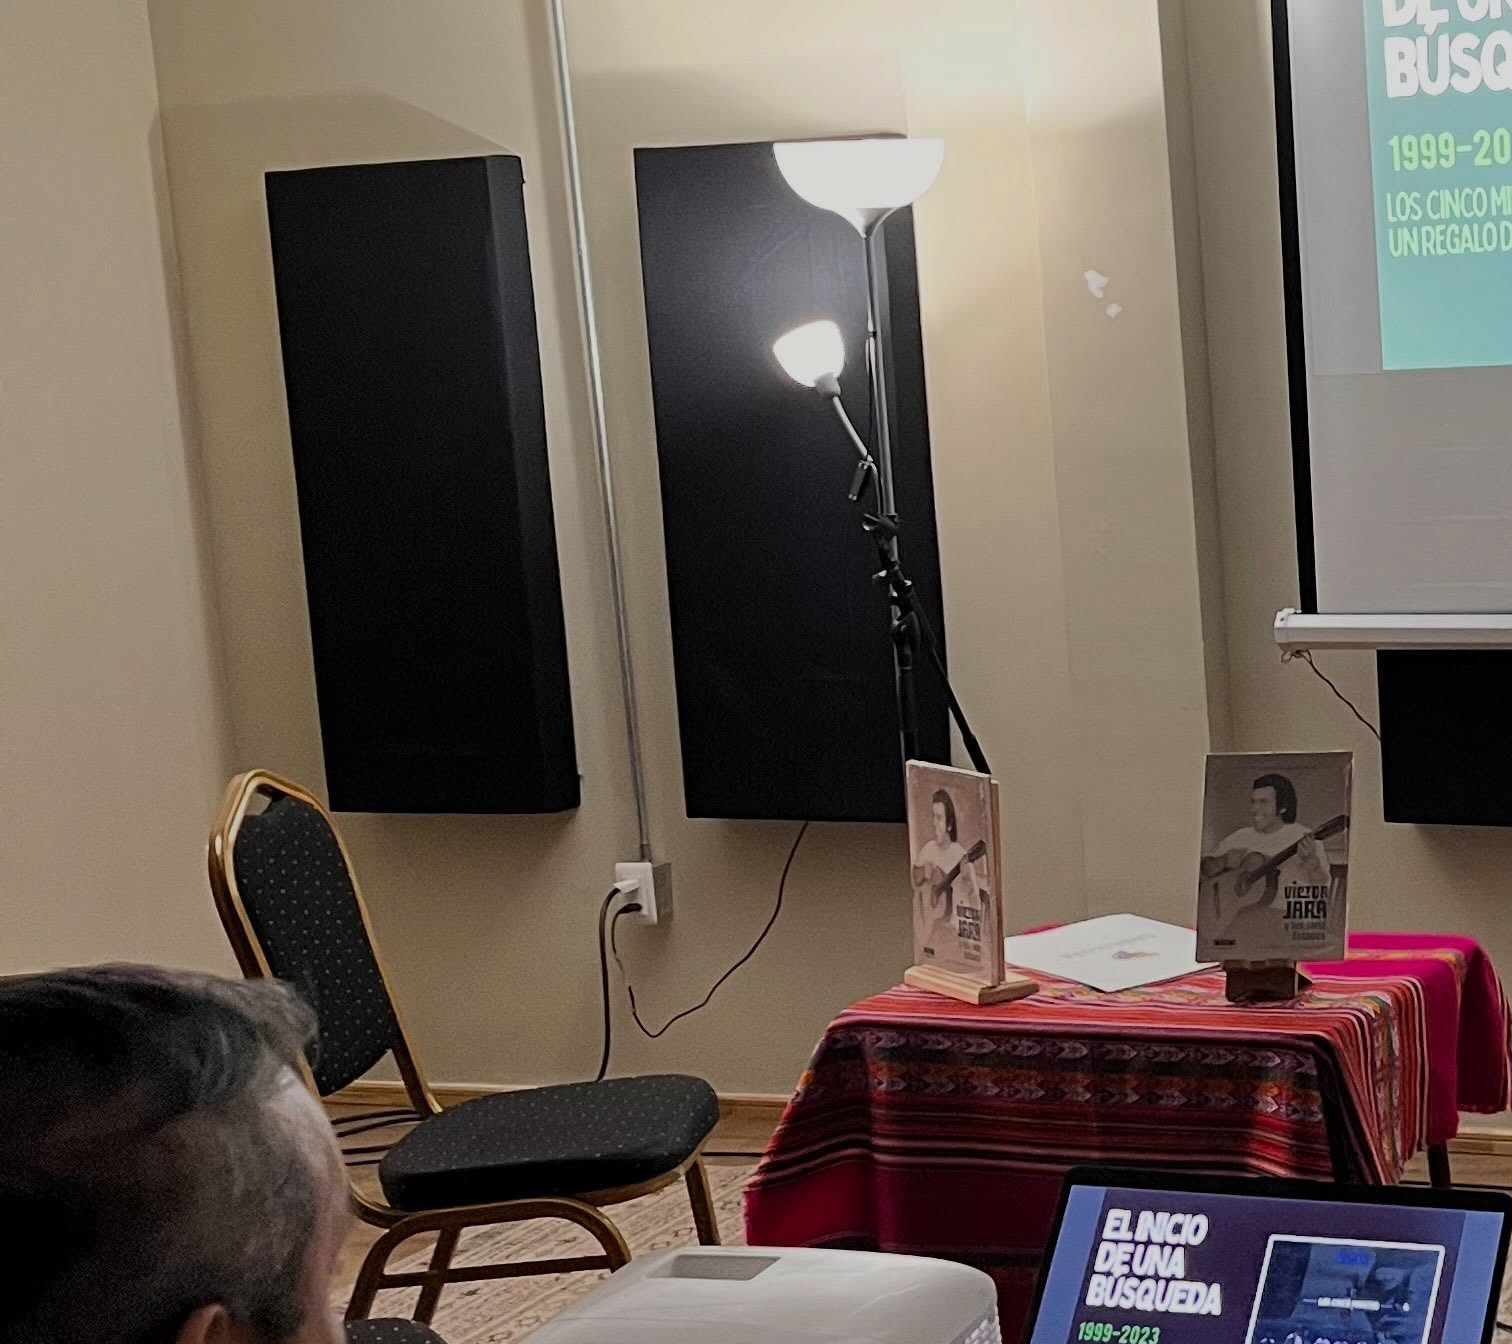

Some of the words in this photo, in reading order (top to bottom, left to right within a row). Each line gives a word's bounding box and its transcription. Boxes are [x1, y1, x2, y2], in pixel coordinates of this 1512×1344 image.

[1386, 192, 1422, 223] LOS
[1426, 187, 1488, 220] CINCO
[1388, 226, 1420, 257] UN
[1421, 221, 1497, 256] REGALO
[1282, 900, 1327, 919] JARA
[1102, 1208, 1133, 1241] EL
[1134, 1210, 1209, 1246] INICIO
[1094, 1241, 1135, 1274] DE
[1132, 1243, 1185, 1279] UNA
